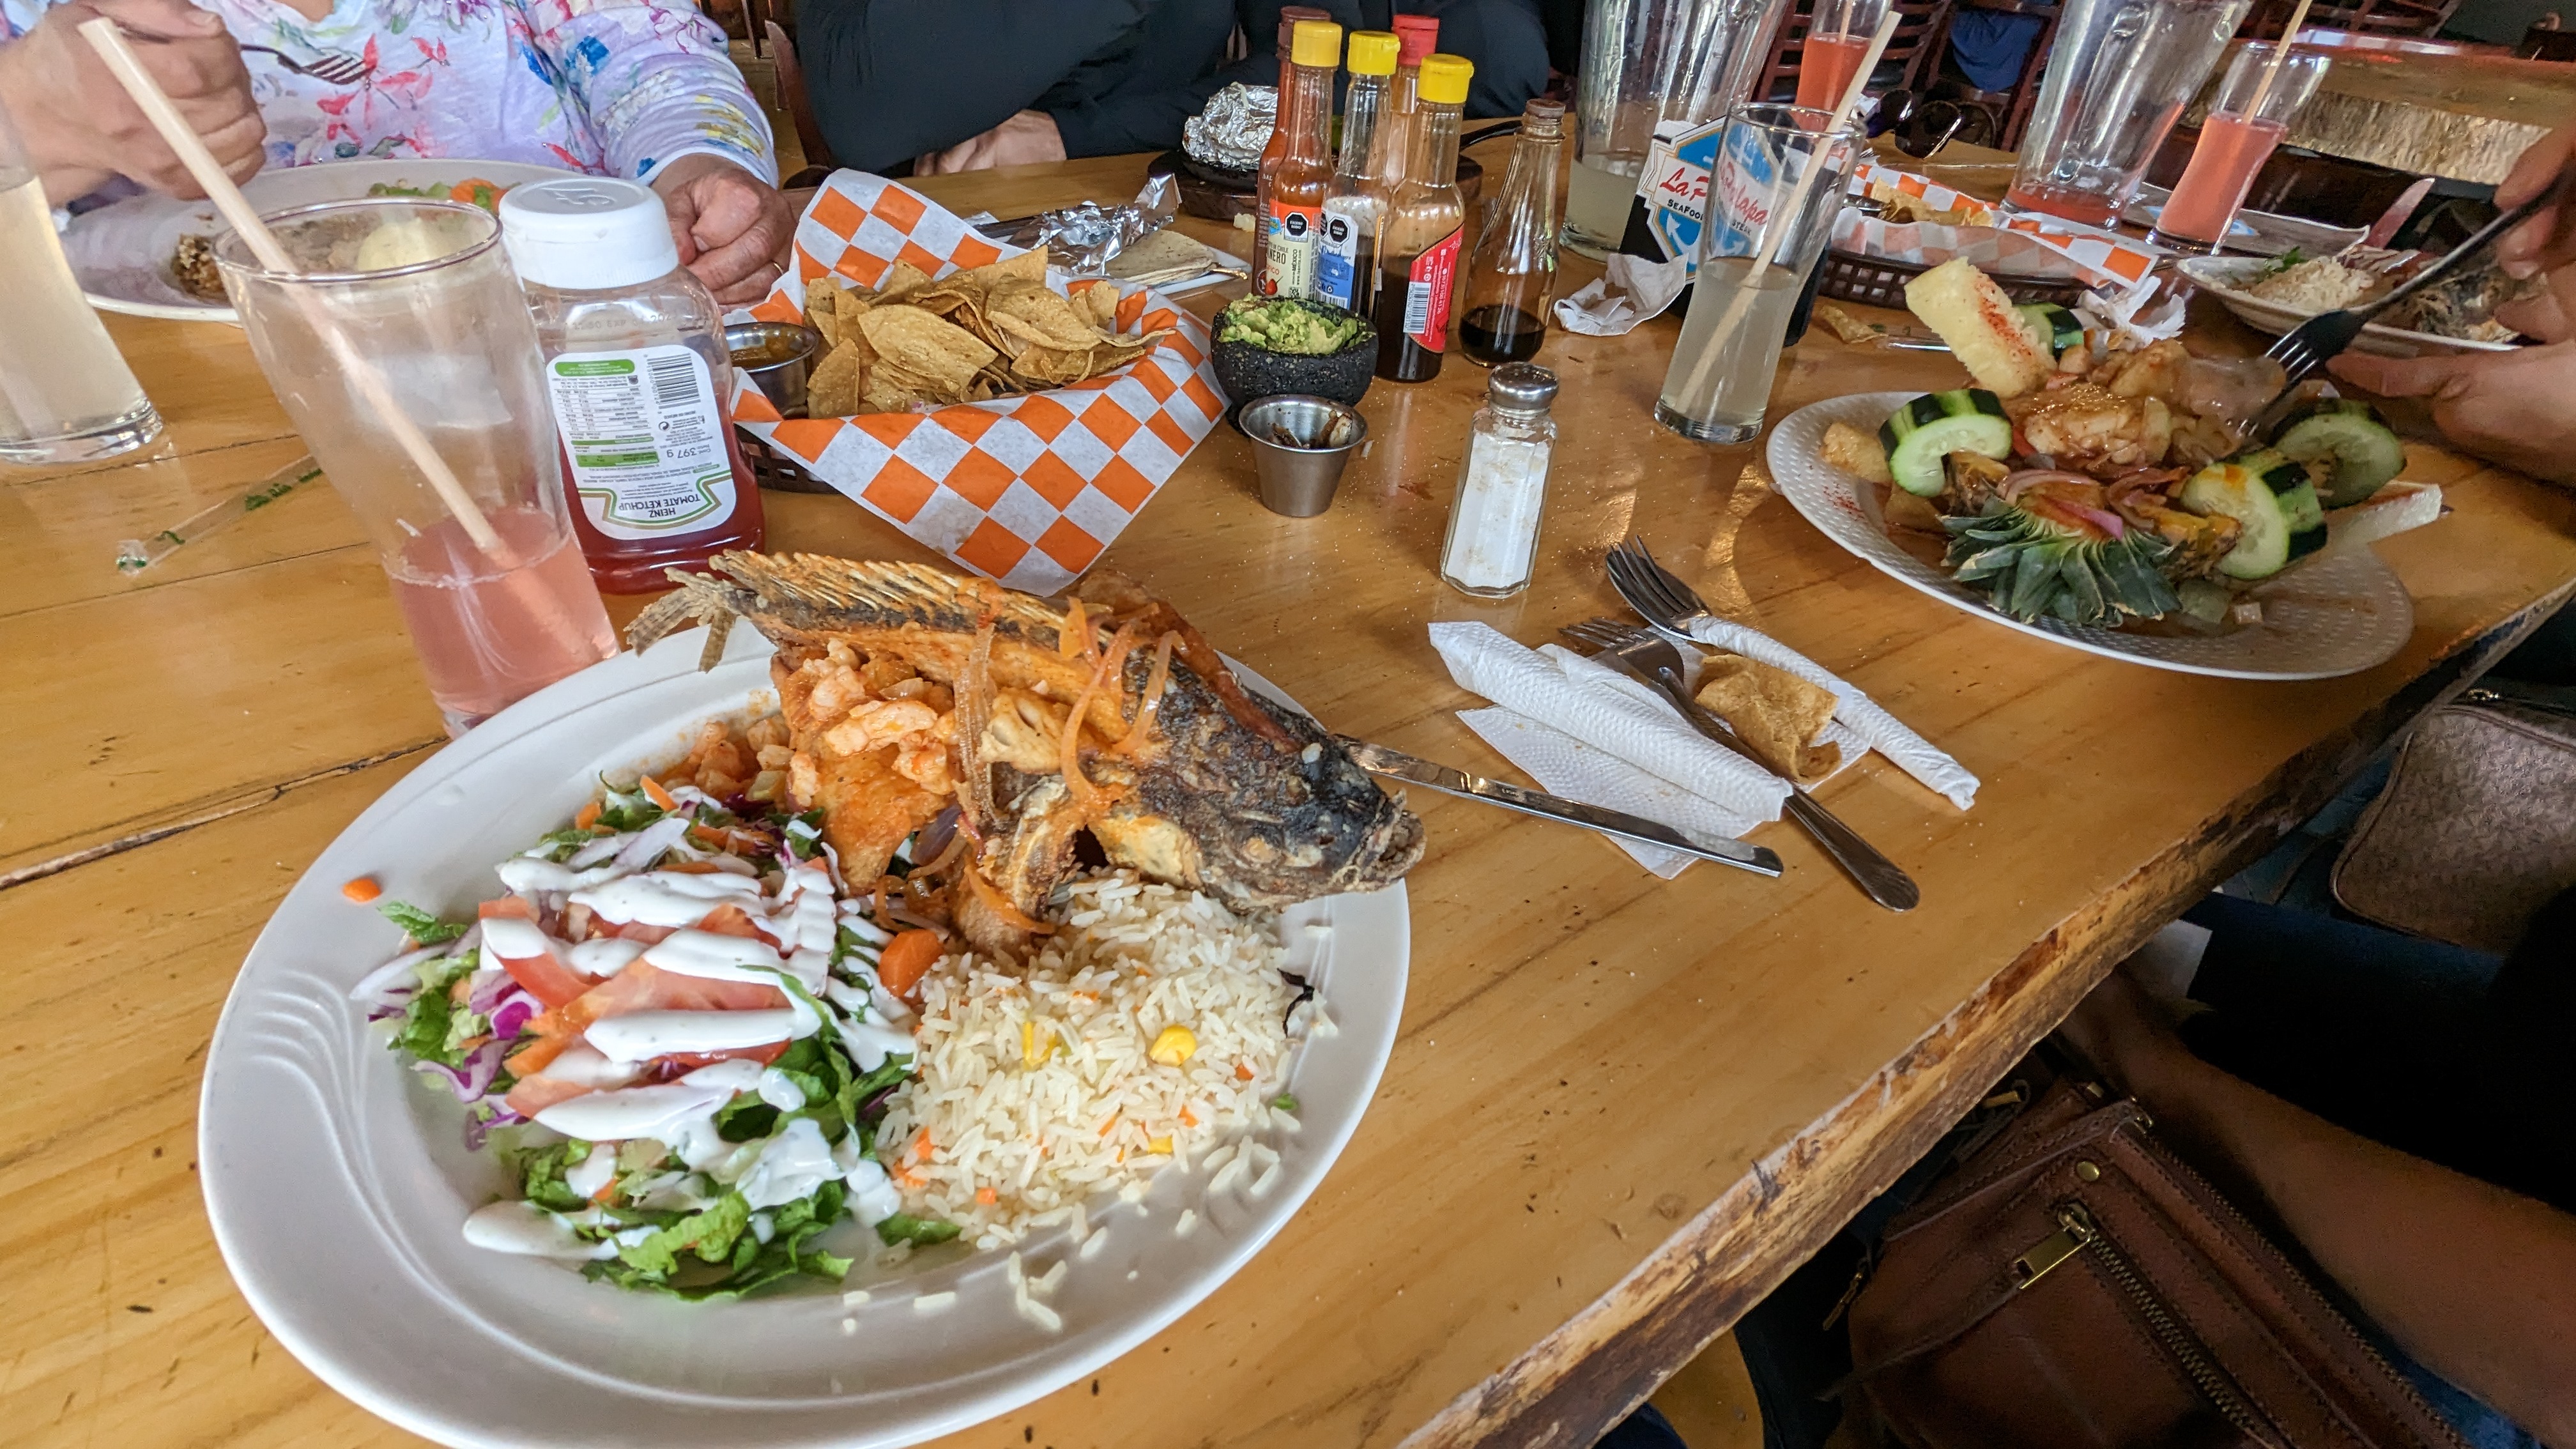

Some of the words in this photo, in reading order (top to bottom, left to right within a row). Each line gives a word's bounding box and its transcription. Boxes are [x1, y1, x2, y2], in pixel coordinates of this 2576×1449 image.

[1659, 167, 1689, 197] La
[677, 447, 697, 459] 397
[618, 500, 662, 511] KETCHUP
[663, 494, 701, 507] TOMATE
[648, 507, 676, 518] HEINZ
